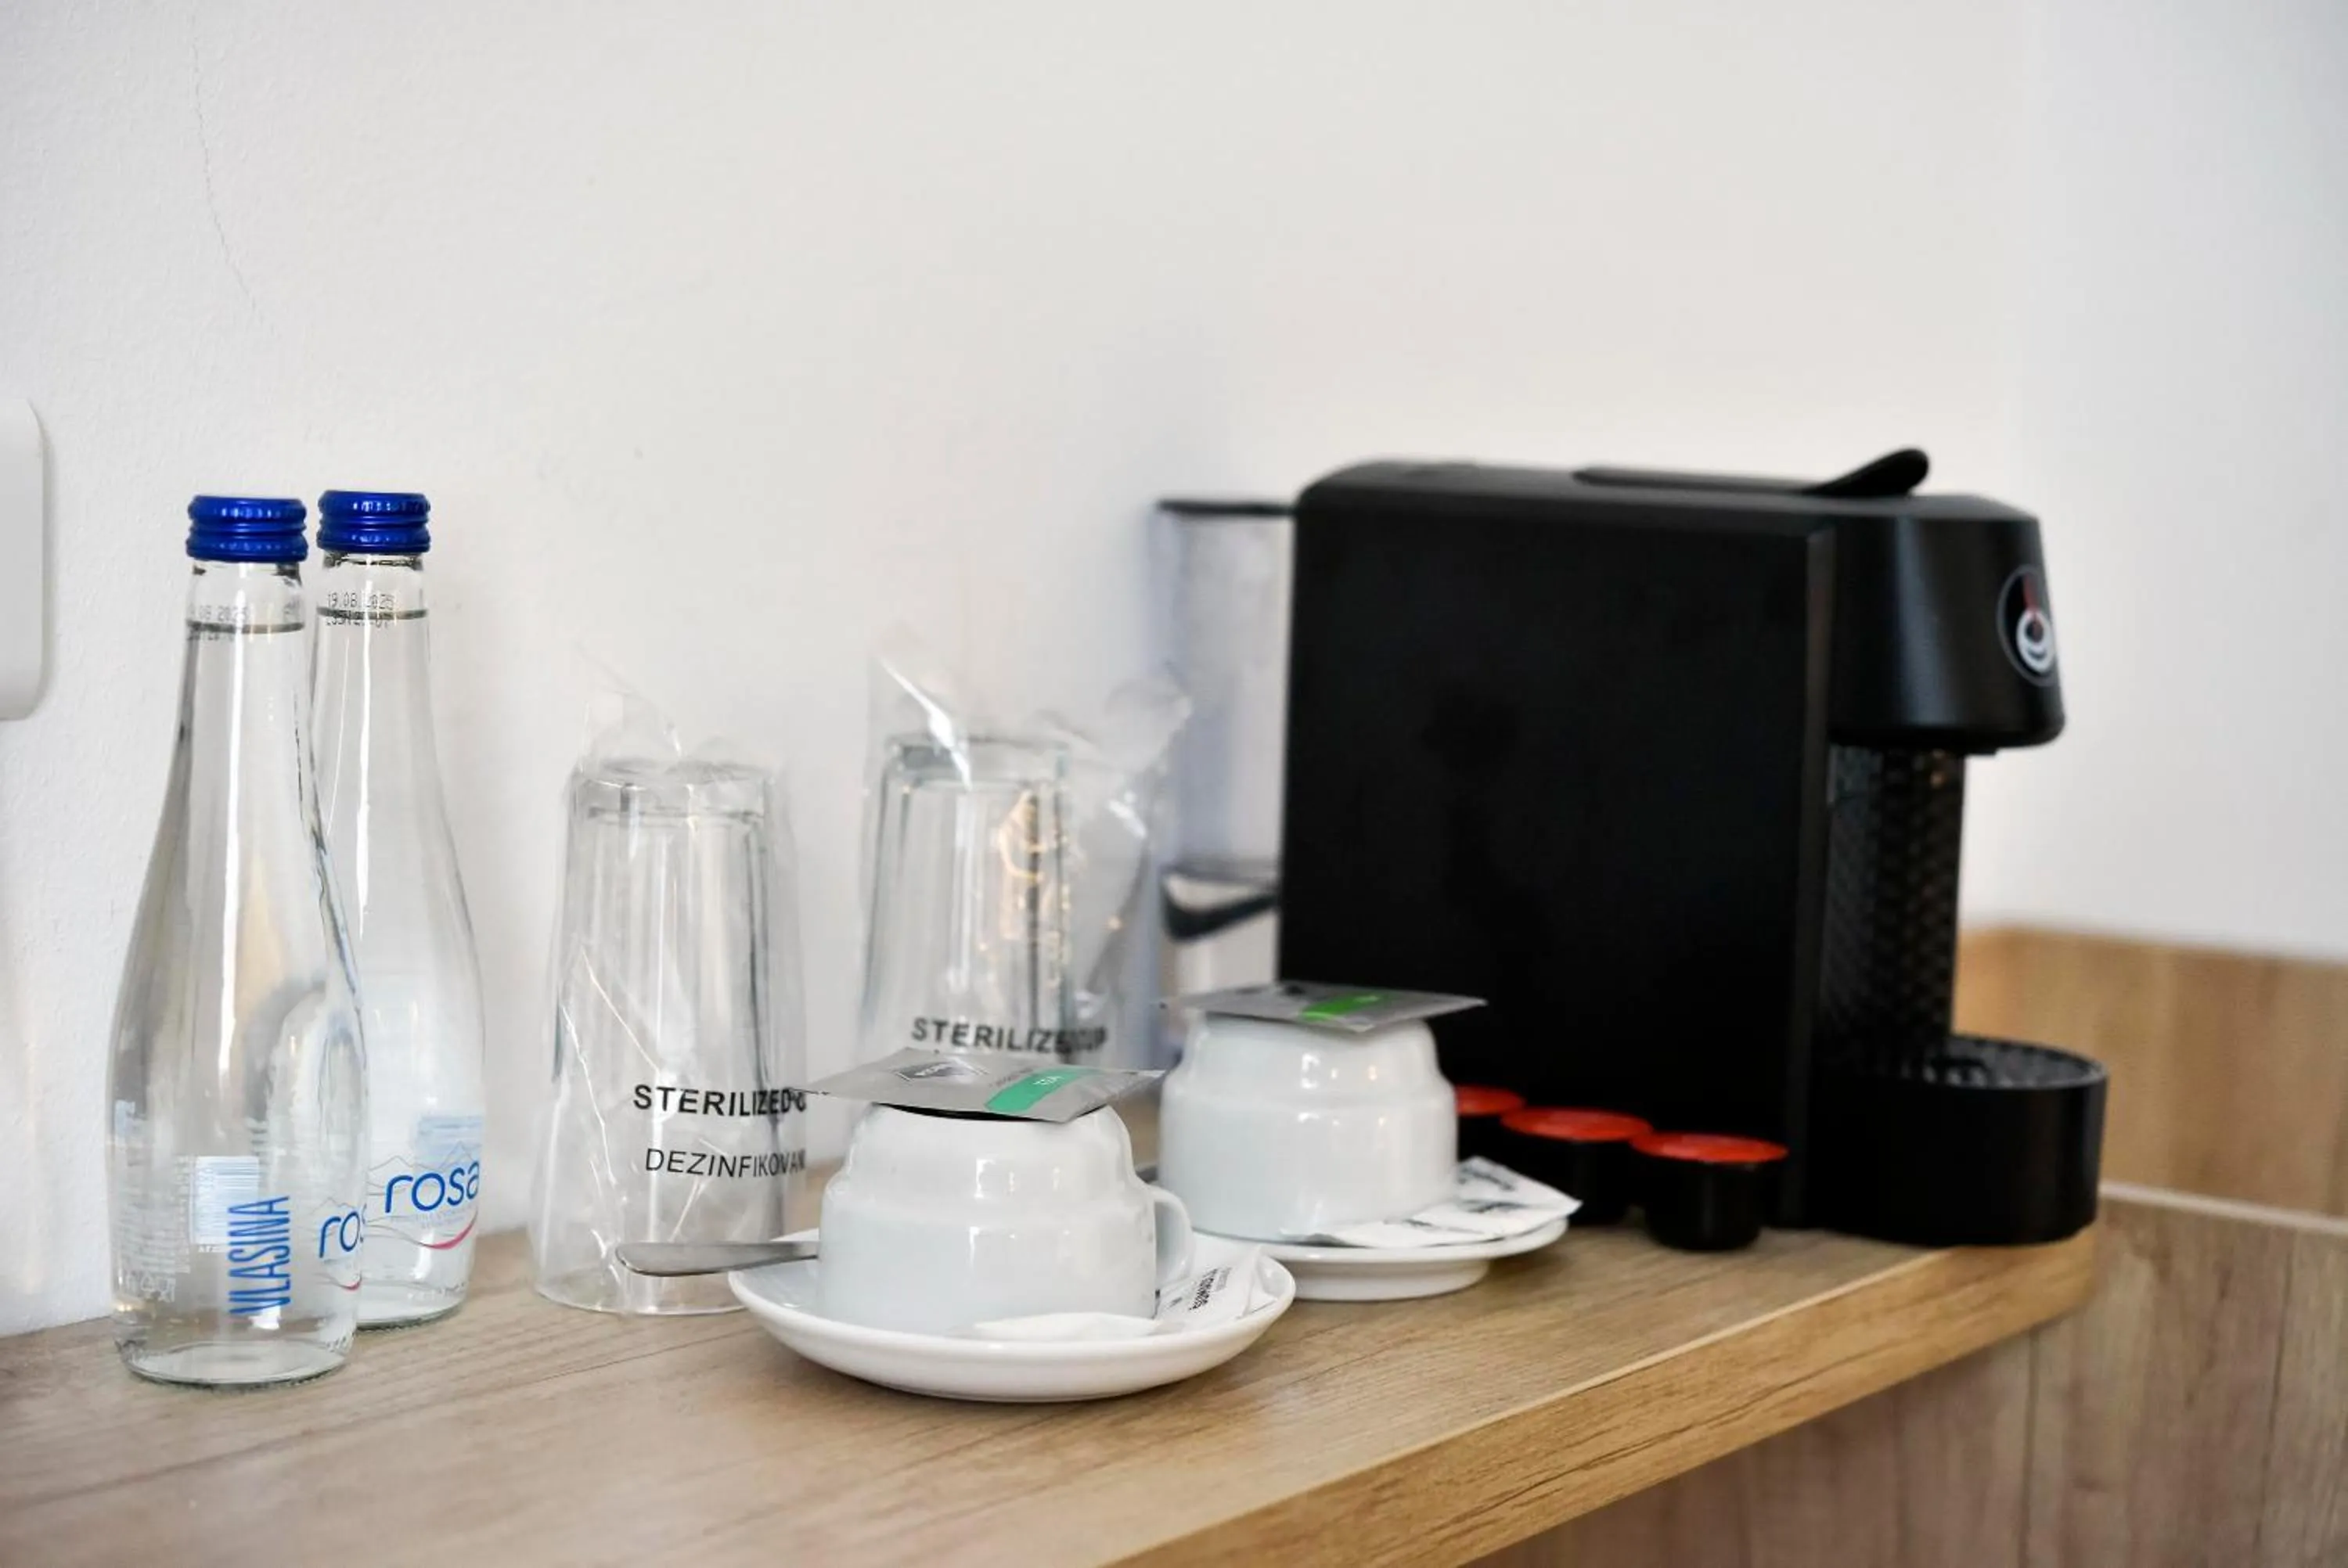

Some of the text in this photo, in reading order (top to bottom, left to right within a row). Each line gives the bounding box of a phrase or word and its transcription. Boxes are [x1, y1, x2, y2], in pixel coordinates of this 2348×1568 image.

[911, 1018, 1076, 1053] STERILIZE
[385, 1161, 479, 1213] rosa
[228, 1195, 290, 1314] VLASINA
